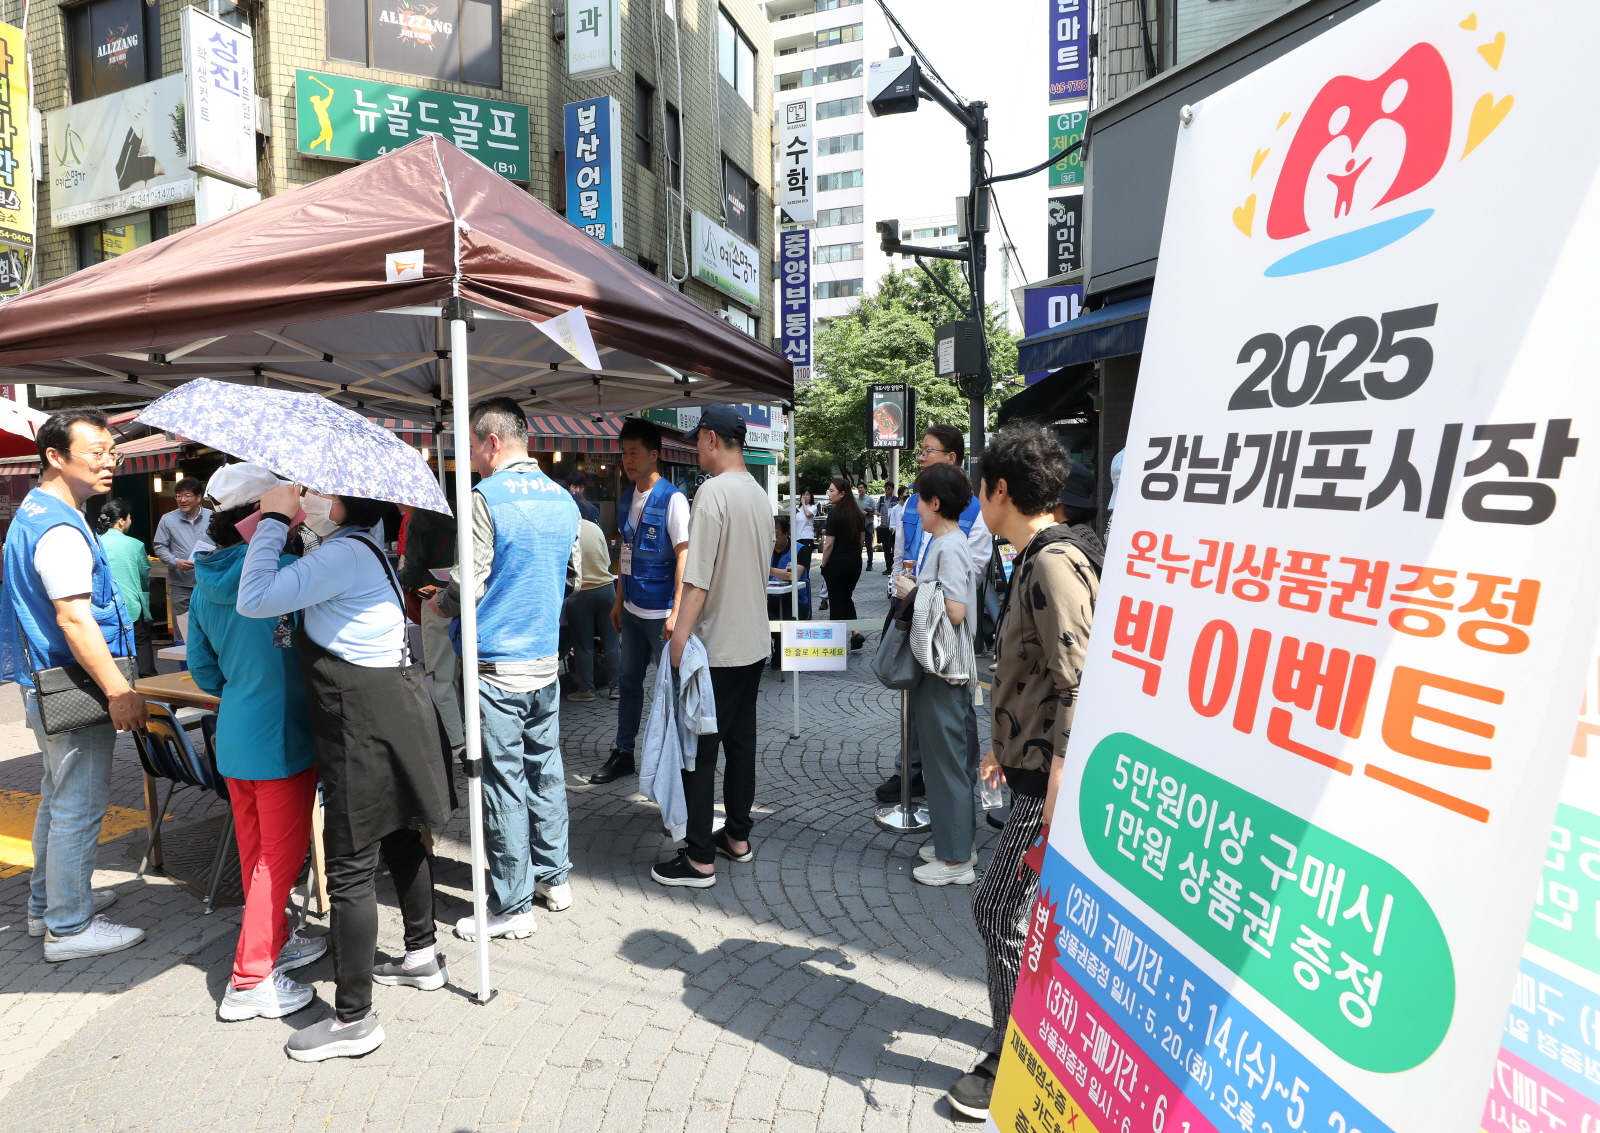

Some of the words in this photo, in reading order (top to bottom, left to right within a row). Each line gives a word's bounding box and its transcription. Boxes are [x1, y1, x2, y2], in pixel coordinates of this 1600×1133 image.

[97, 34, 138, 57] ALLZZANG
[208, 32, 240, 97] 성진
[379, 10, 452, 34] ALLZZANG
[576, 7, 603, 37] 과
[352, 88, 520, 151] 뉴골드골프
[576, 104, 600, 220] 부산어묵
[1057, 113, 1083, 131] GP
[493, 161, 517, 175] (B1)
[786, 136, 809, 197] 수학
[720, 244, 757, 284] 예손명가
[784, 233, 808, 363] 중앙부동산
[1227, 303, 1439, 411] 2025
[1140, 418, 1580, 526] 강남개포시장
[796, 629, 820, 639] 줄서는
[823, 629, 831, 639] 곳
[1126, 530, 1541, 655] 온누리상품권증정
[784, 648, 792, 657] 한
[794, 648, 809, 657] 줄로
[812, 648, 819, 657] 서
[822, 648, 844, 657] 주세요
[1112, 595, 1174, 697] 빅
[1188, 618, 1506, 824] 이벤트
[1112, 753, 1254, 866] 5만원이상
[1260, 833, 1395, 957] 구매시
[1027, 901, 1051, 973] 변경
[1066, 883, 1100, 939] (2차)
[1102, 913, 1163, 996] 구매기간
[1104, 803, 1172, 882] 1만원
[1178, 852, 1282, 960] 상품권
[1290, 923, 1384, 1029] 증정
[1010, 1029, 1067, 1116] 재발행영수증
[1038, 1017, 1088, 1088] 상품권증정
[1087, 1076, 1113, 1119] 일시
[1046, 975, 1079, 1035] (3차)
[1080, 1011, 1139, 1104] 구매기간
[1058, 925, 1111, 989] 상품권증정
[1110, 975, 1137, 1016] 일시
[1219, 1083, 1256, 1133] 오후
